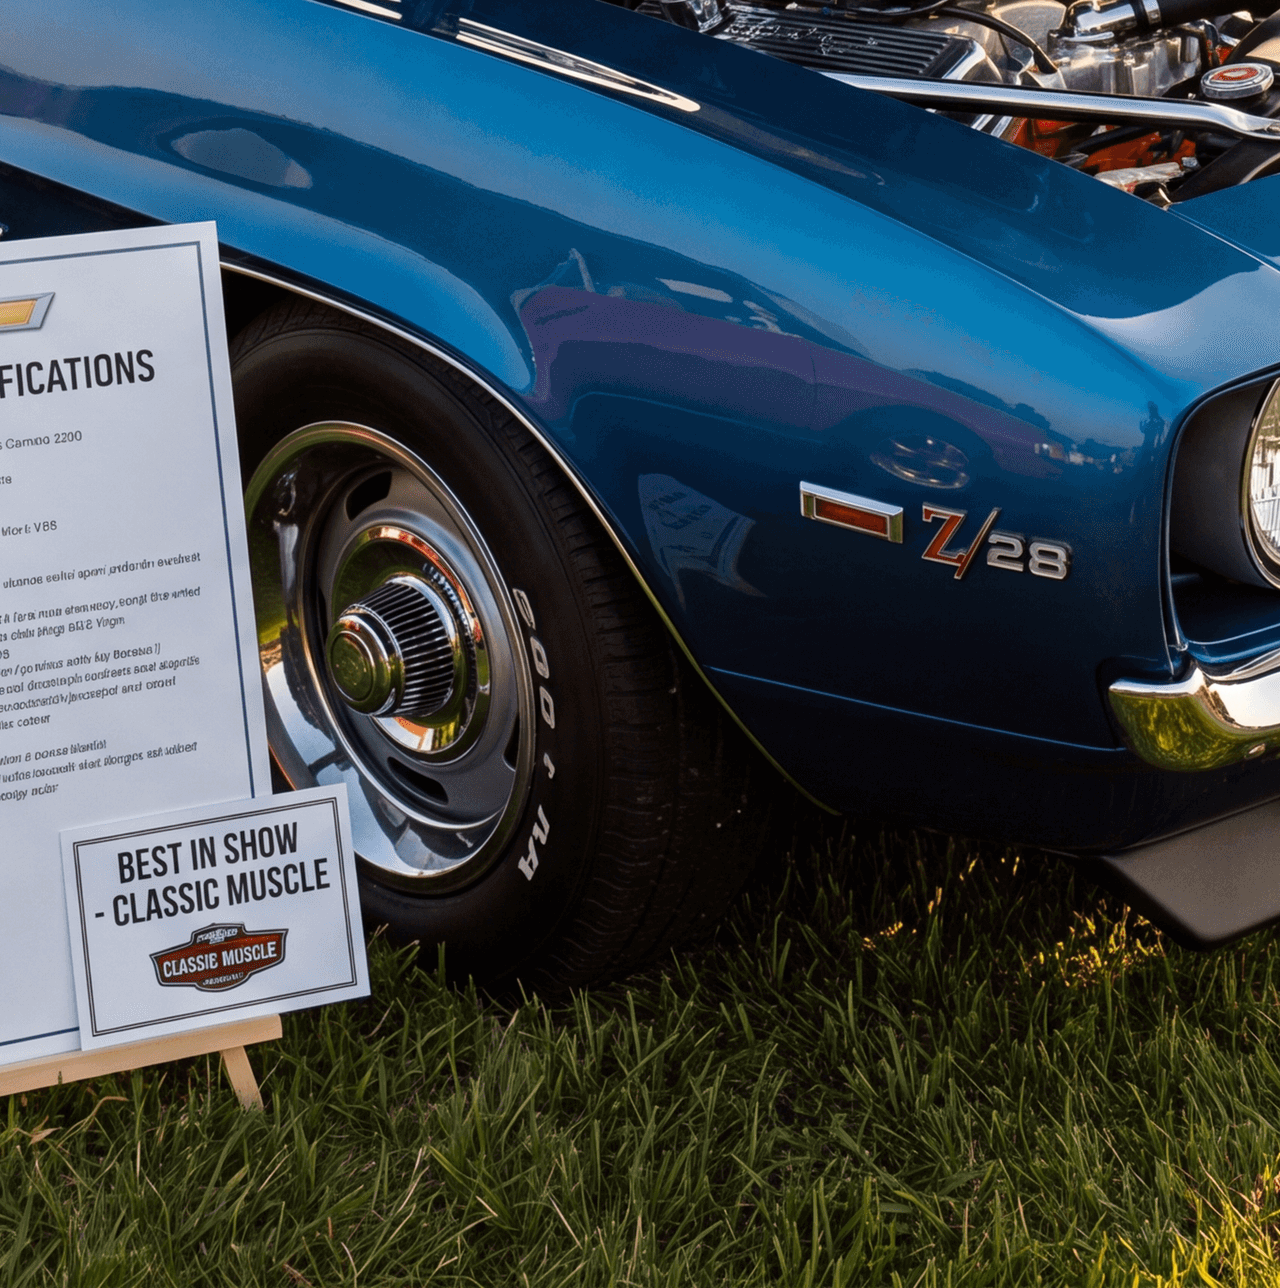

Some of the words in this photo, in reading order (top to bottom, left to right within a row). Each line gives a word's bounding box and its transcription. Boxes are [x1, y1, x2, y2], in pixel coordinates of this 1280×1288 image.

[921, 502, 1072, 580] Z/28
[117, 842, 182, 884] BEST
[190, 836, 217, 871] IN
[223, 822, 298, 864] SHOW
[112, 878, 220, 927] CLASSIC
[226, 857, 331, 906] MUSCLE
[221, 941, 277, 967] MUSCLE
